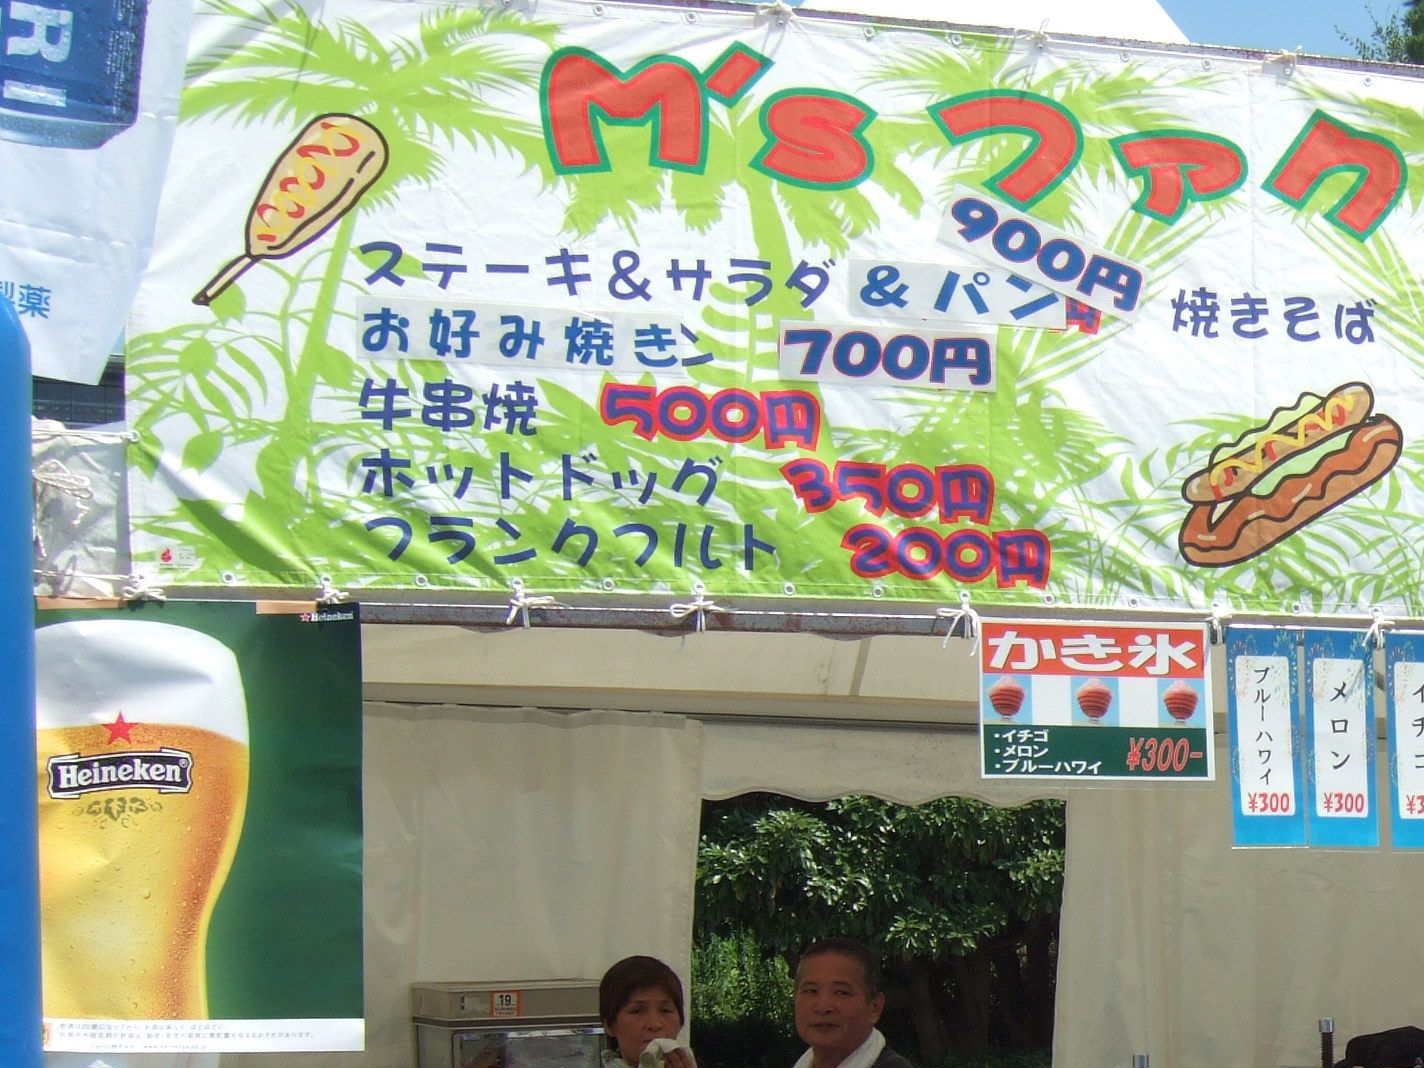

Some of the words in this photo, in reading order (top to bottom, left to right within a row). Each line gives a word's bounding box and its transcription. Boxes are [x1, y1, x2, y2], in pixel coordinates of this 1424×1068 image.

[539, 41, 878, 191] M's
[950, 196, 1144, 313] 900円
[360, 306, 683, 368] お好み焼き
[1171, 286, 1380, 345] 焼きそば
[782, 328, 994, 387] 700円
[358, 377, 540, 438] 牛串焼
[601, 383, 821, 451] 500円
[361, 449, 727, 505] ホットドッグ
[780, 459, 996, 526] 350円
[364, 516, 778, 573] フランクフルト
[841, 528, 1052, 590] 200円
[988, 630, 1199, 676] かき氷
[1253, 666, 1274, 786] ブルーハワイ
[1329, 680, 1352, 771] メロン
[58, 758, 183, 789] Heineken
[1247, 791, 1291, 814] ¥300
[1323, 791, 1366, 814] ¥300
